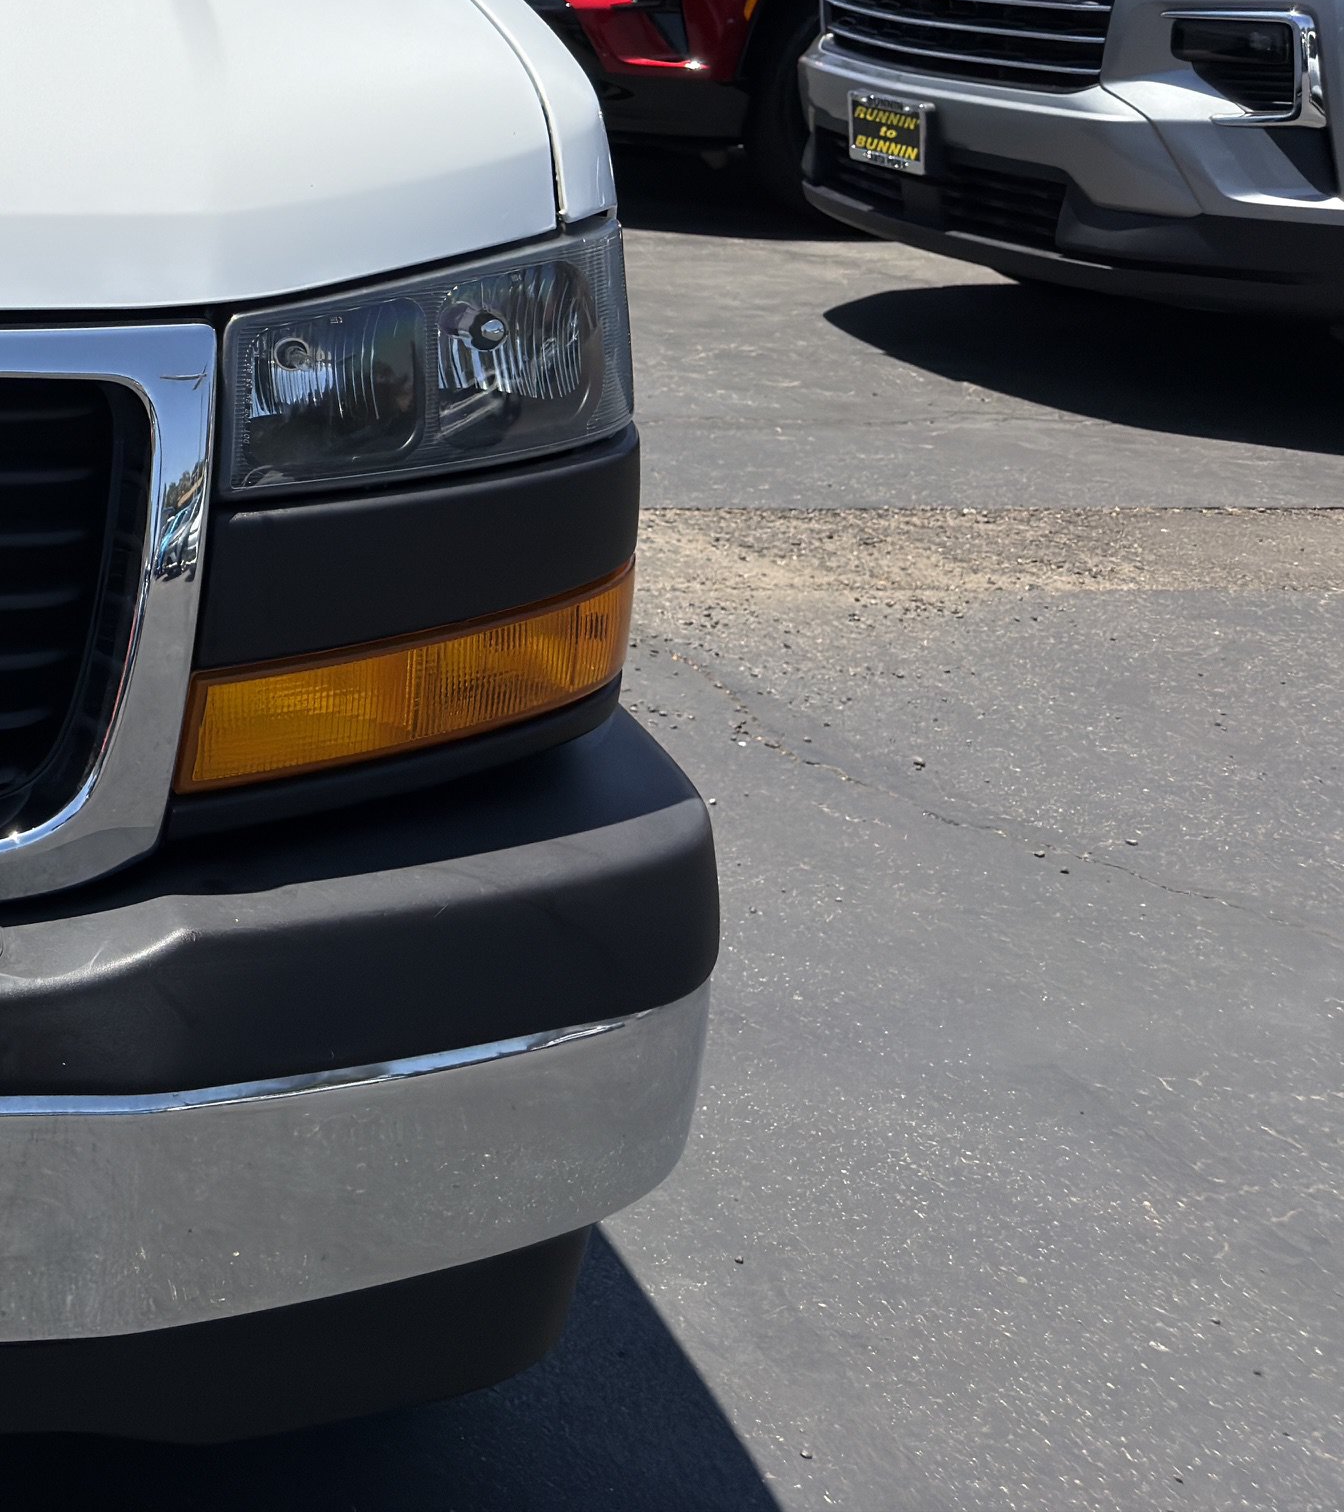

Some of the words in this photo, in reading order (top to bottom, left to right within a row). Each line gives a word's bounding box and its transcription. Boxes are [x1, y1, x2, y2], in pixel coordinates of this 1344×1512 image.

[854, 105, 920, 130] RUNNIN'
[879, 126, 897, 139] to
[855, 134, 918, 160] BUNNIN
